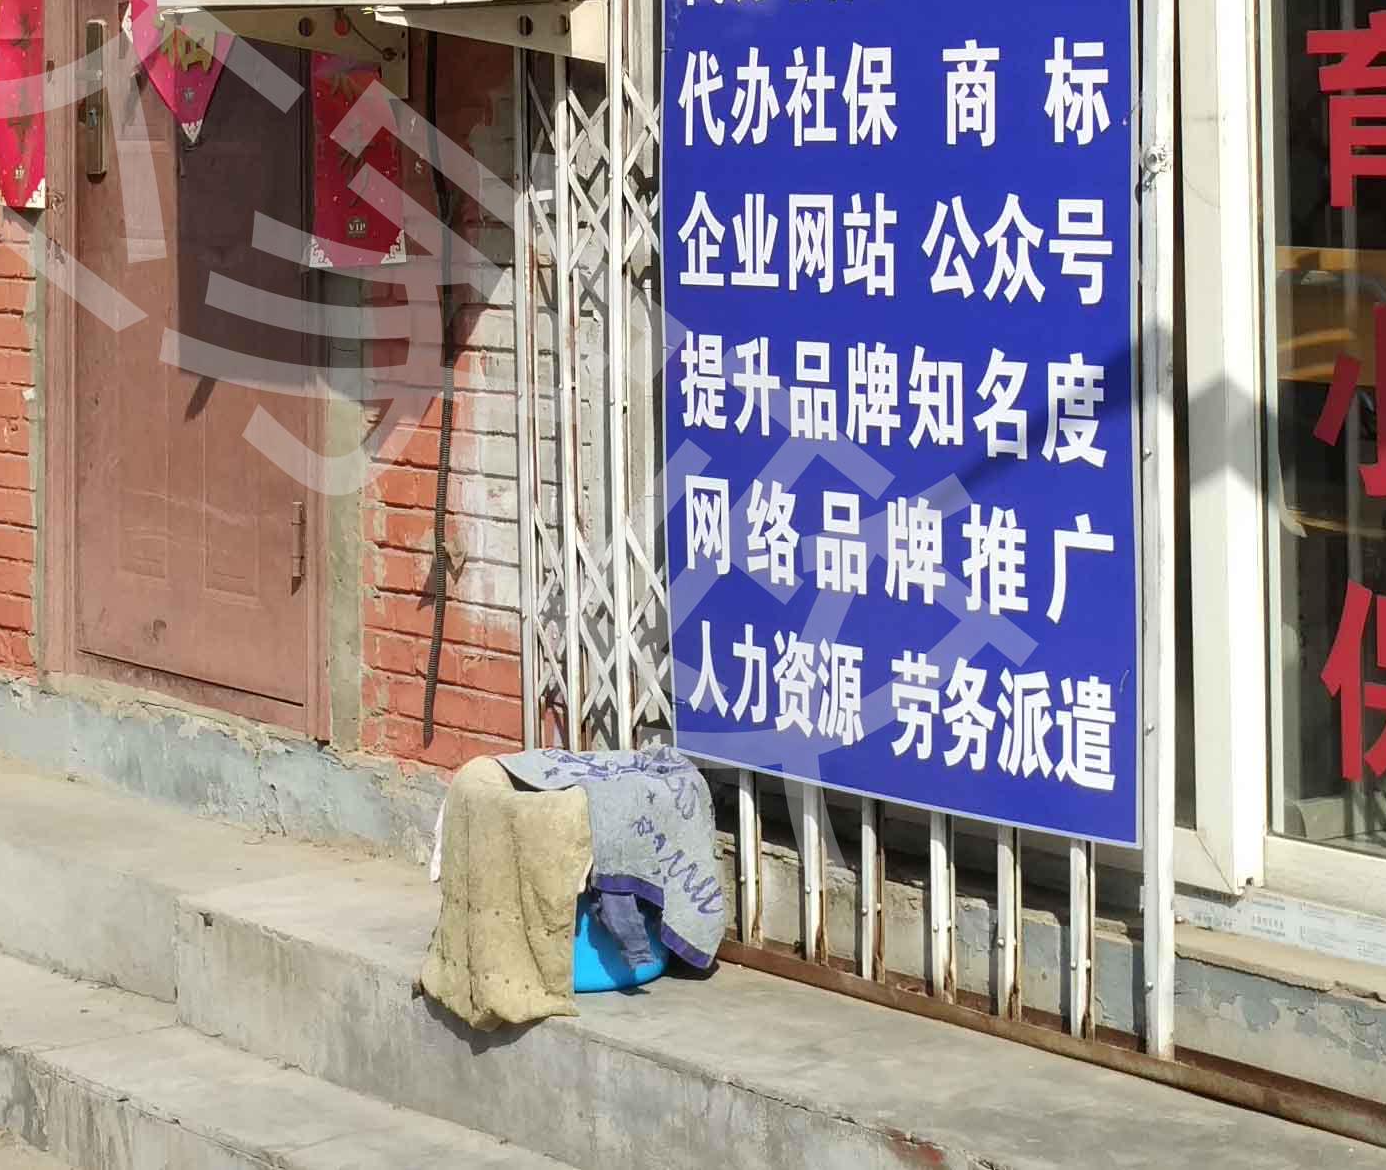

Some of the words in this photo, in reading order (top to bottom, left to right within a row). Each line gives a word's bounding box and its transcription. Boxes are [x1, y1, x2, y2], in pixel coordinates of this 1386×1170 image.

[677, 41, 898, 147] 代办社保
[942, 36, 1111, 147] 商标
[677, 190, 897, 297] 企业网站
[921, 193, 1113, 305] 公众号
[680, 329, 1108, 469] 提升品牌知名度
[685, 473, 1114, 624] 网络品牌推广
[689, 619, 864, 745] 人力资源
[891, 649, 1116, 792] 劳务派遣
